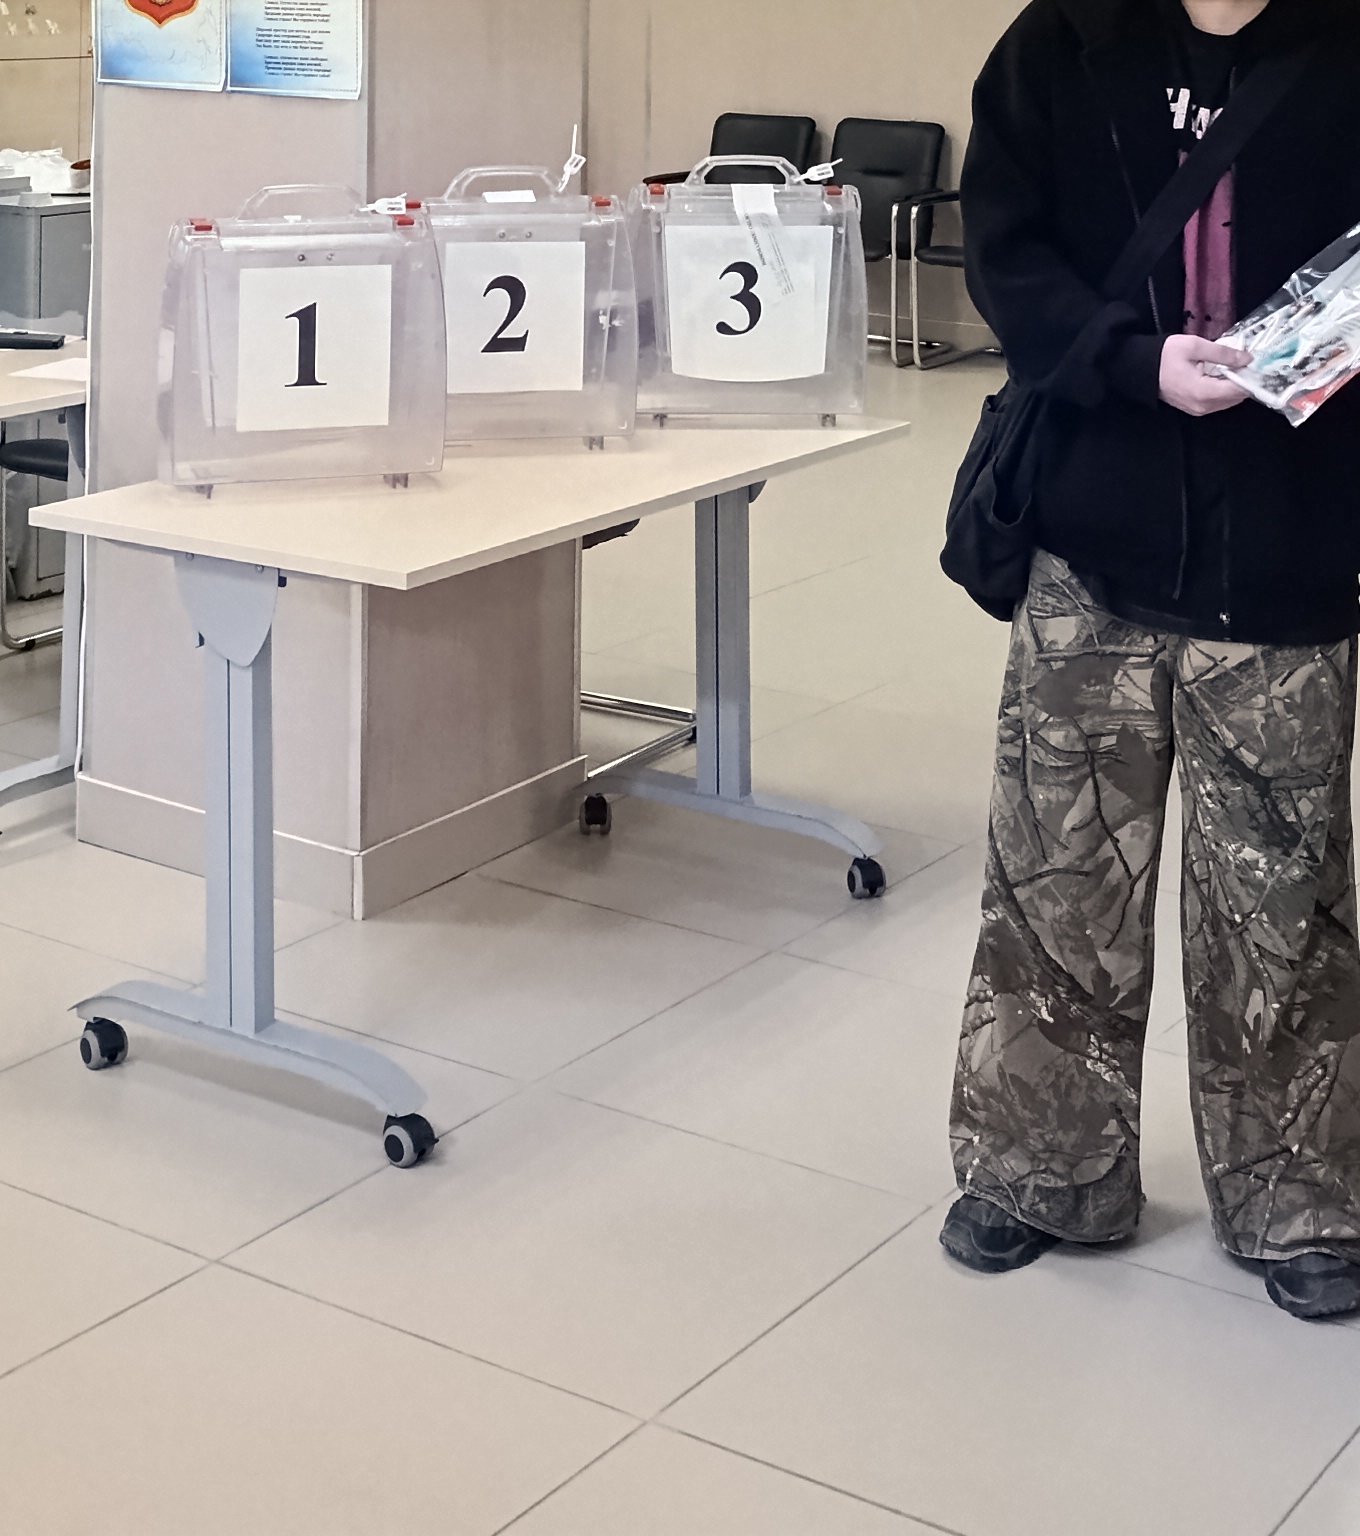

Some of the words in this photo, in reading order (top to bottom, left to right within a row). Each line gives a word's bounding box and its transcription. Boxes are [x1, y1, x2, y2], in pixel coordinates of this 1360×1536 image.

[481, 275, 529, 353] 2
[715, 261, 762, 336] 3
[284, 302, 328, 387] 1
